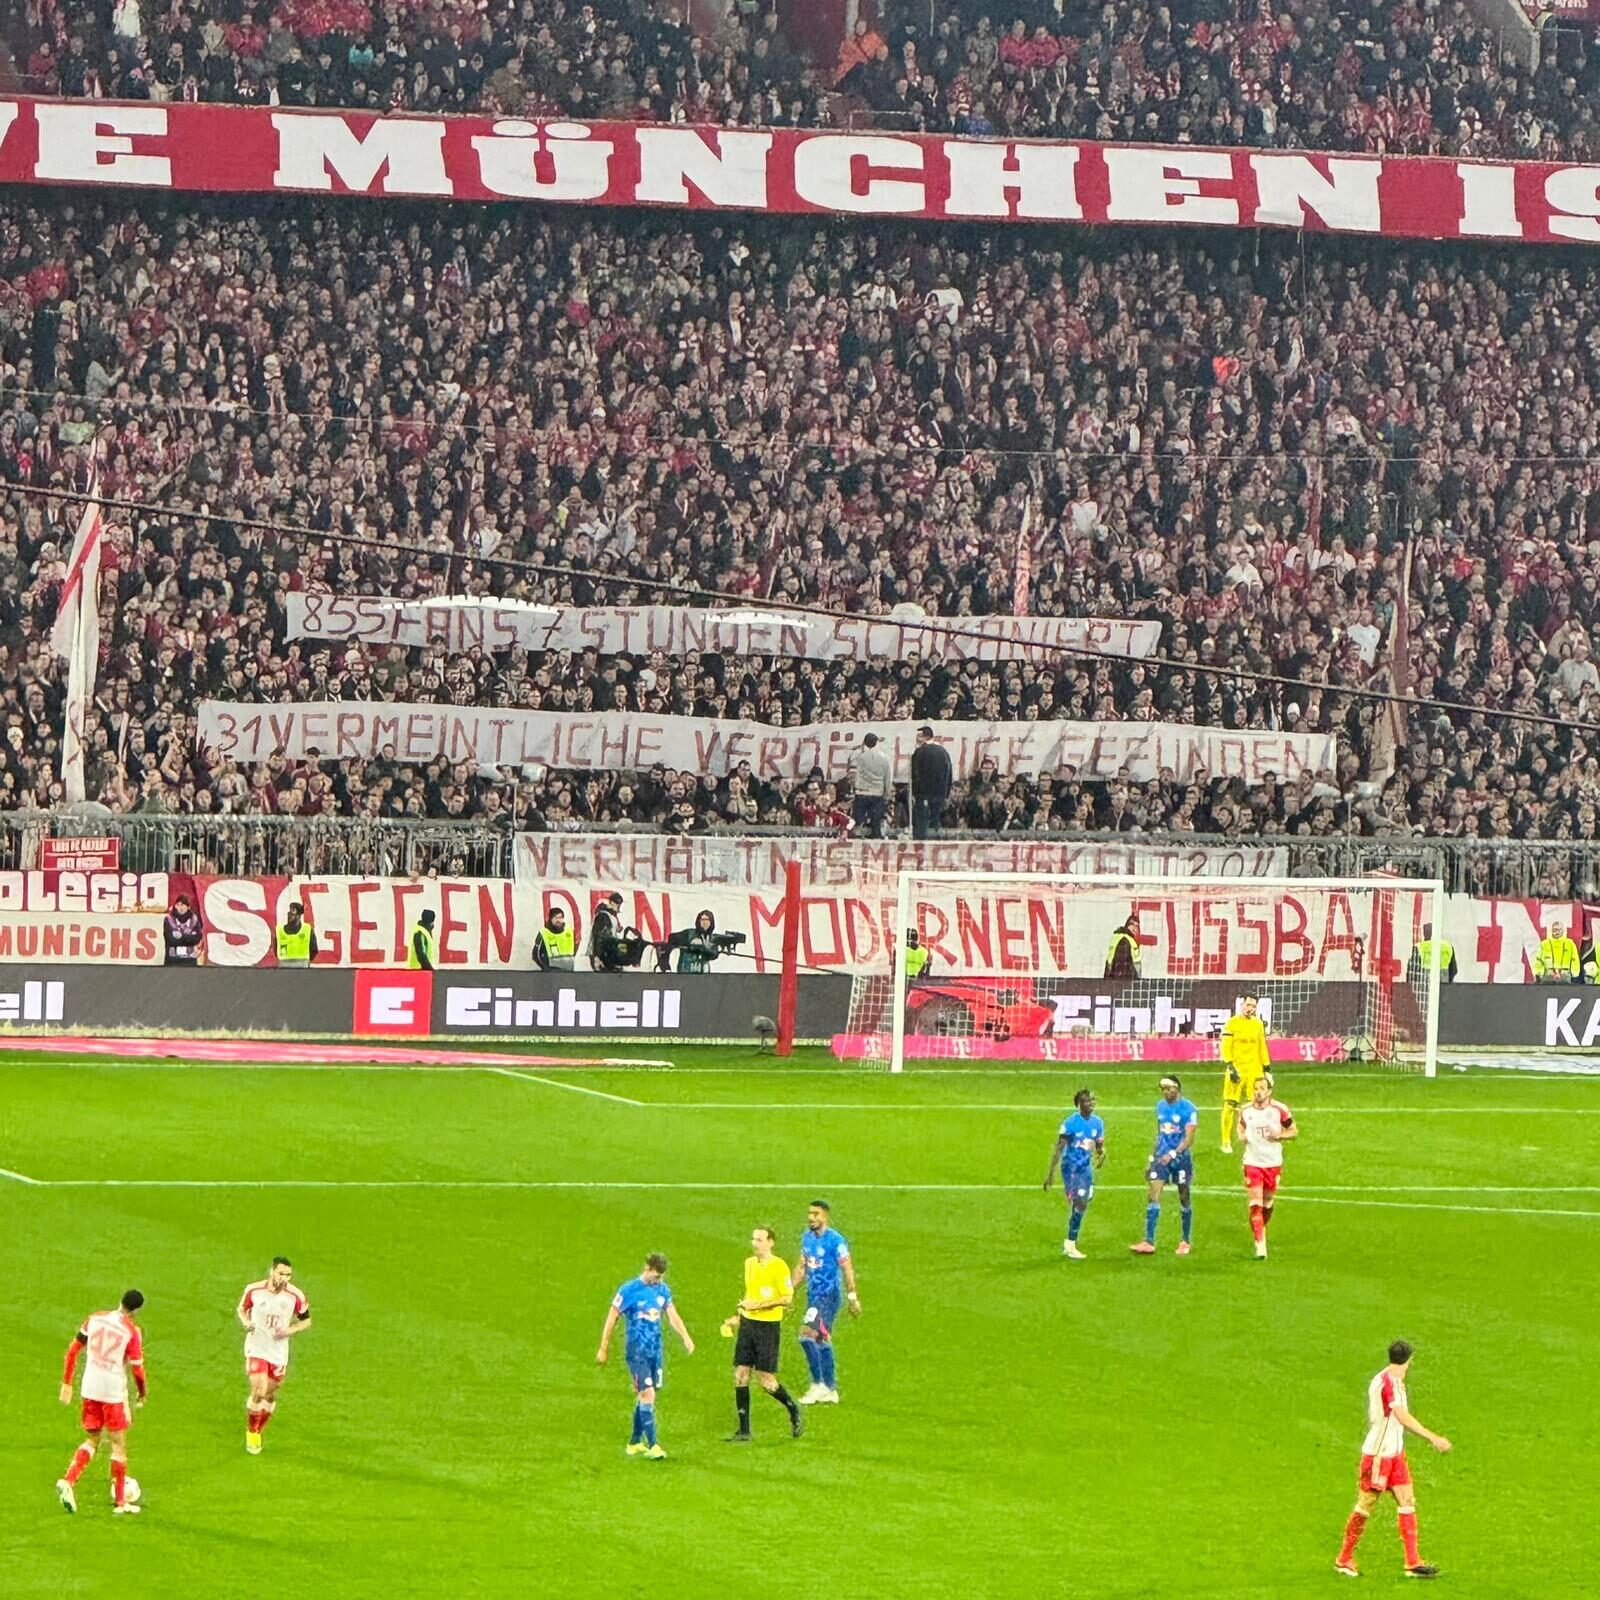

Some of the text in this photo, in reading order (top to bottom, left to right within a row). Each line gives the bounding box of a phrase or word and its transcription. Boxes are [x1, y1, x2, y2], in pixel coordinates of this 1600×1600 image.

[0, 102, 172, 186] E
[271, 113, 1382, 234] MÜNCHEN
[542, 609, 566, 648] 7
[445, 986, 681, 1028] Einhell
